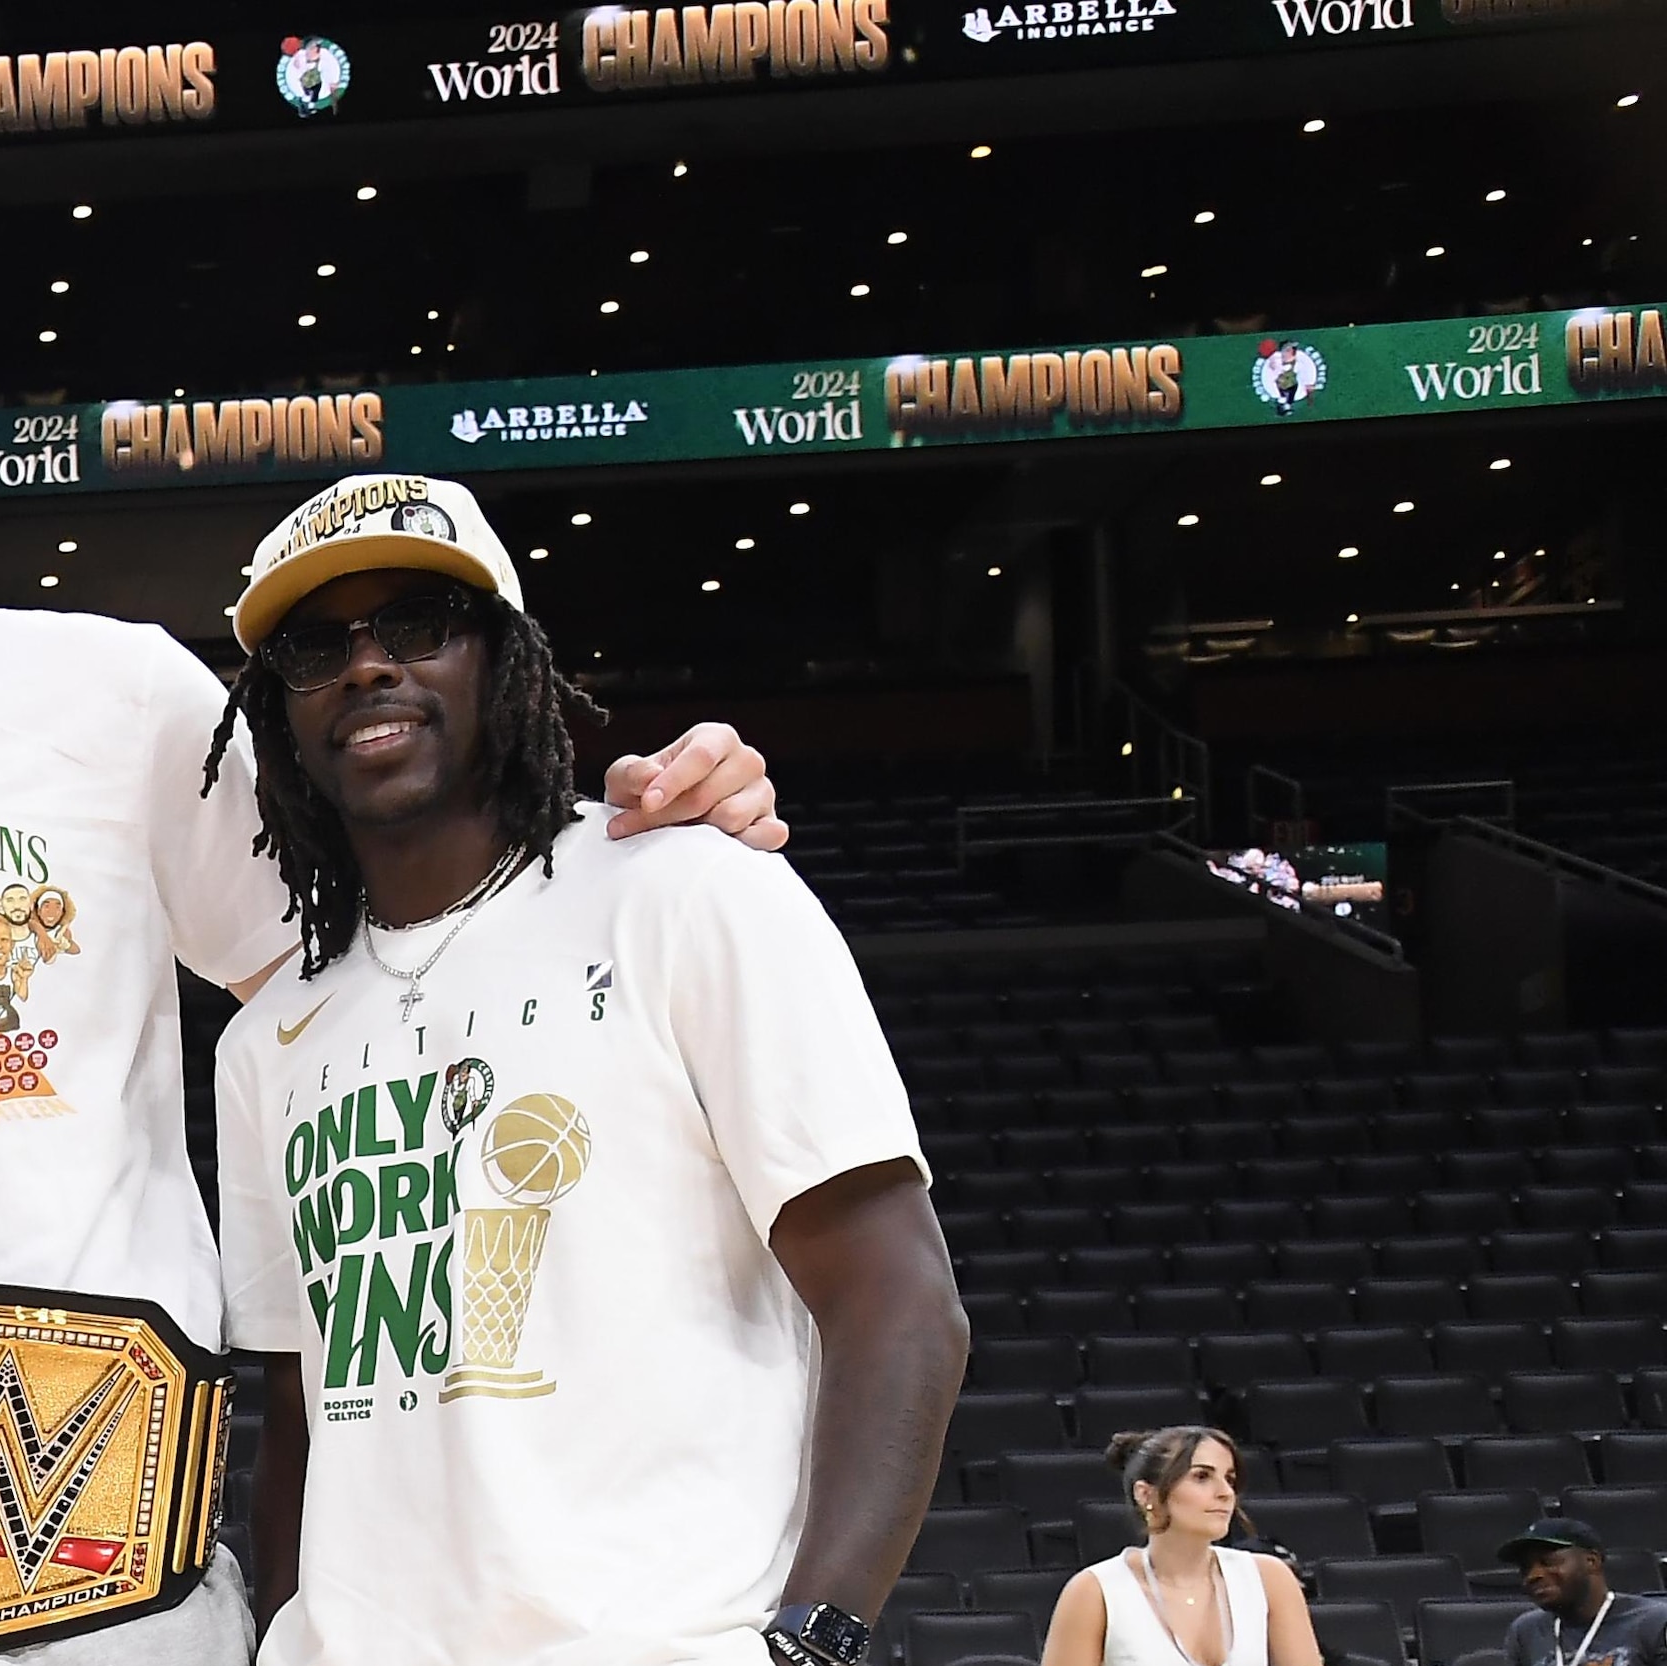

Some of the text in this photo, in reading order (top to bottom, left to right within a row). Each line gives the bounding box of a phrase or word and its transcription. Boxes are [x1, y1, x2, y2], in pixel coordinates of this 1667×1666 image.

[993, 0, 1177, 30] ARBELLA
[1016, 17, 1155, 41] INSURANCE
[1277, 0, 1415, 38] World
[490, 22, 560, 54] 2024
[582, 0, 890, 92] CHAMPIONS
[429, 55, 560, 102] World
[1467, 322, 1539, 353] 2024
[792, 371, 861, 399] 2024
[884, 344, 1181, 436] CHAMPIONS
[1406, 353, 1542, 402] World
[13, 415, 79, 443] 2024
[479, 401, 647, 430] ARBELLA
[501, 424, 627, 441] INSURANCE
[733, 402, 862, 446] World
[100, 392, 384, 475] CHAMPIONS
[267, 477, 429, 568] AMPIONS
[290, 486, 339, 535] NBA
[285, 1071, 438, 1198] ONLY
[323, 1398, 373, 1412] BOSTON
[327, 1409, 372, 1422] CELTICS
